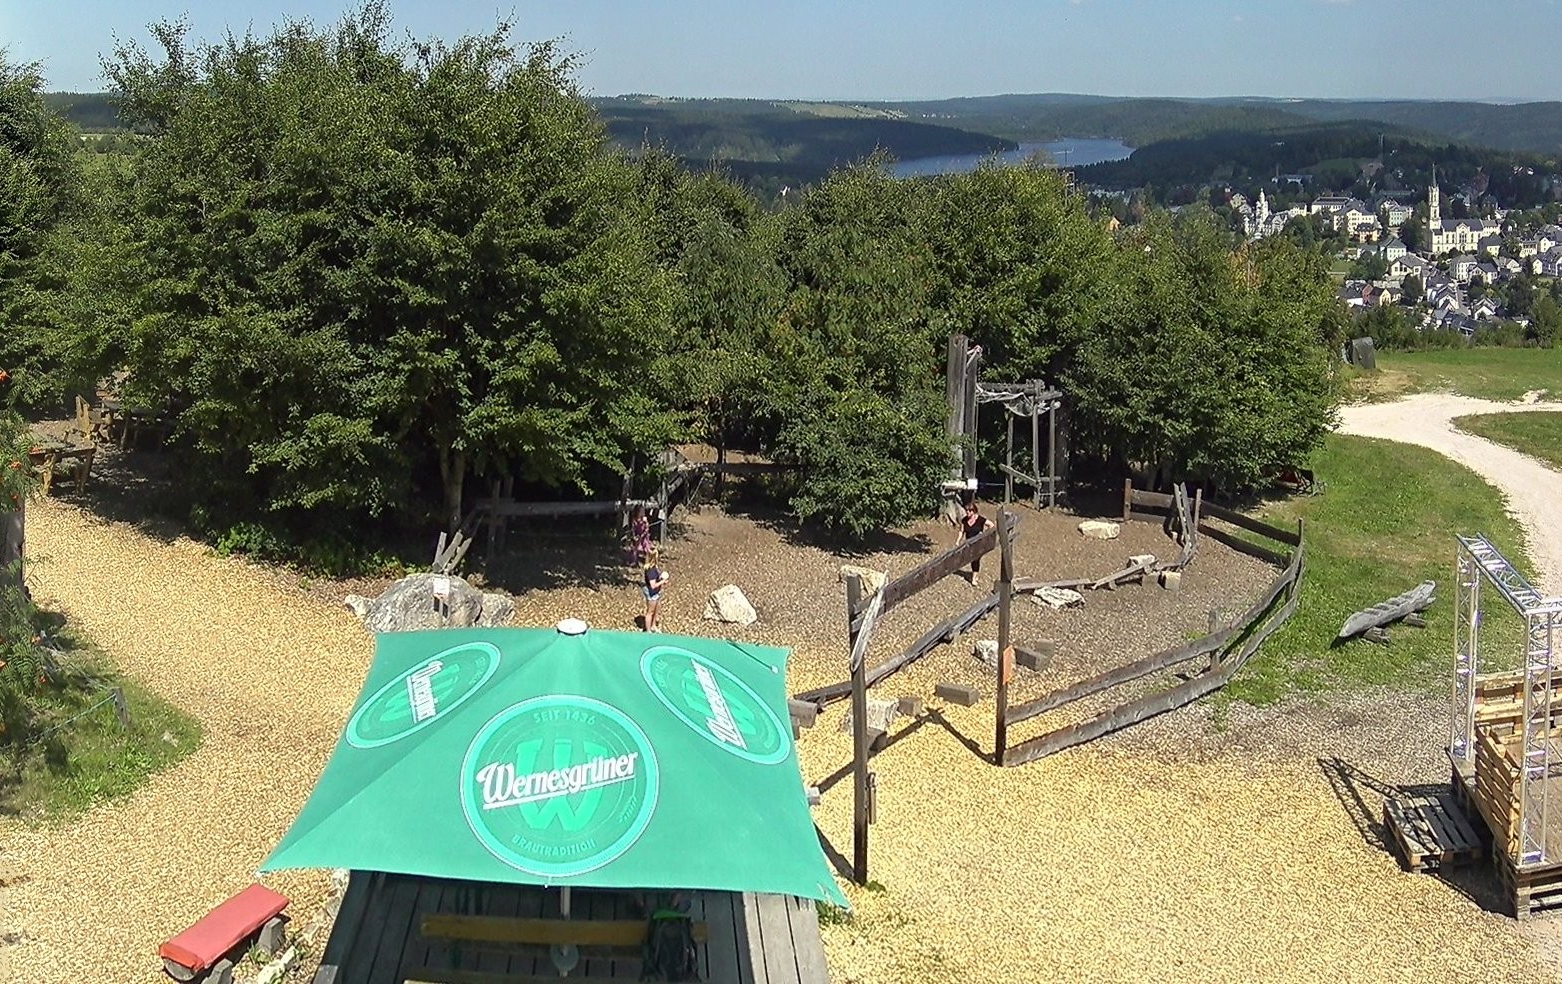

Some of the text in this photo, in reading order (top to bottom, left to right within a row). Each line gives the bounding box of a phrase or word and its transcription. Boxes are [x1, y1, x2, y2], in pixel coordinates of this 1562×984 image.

[533, 709, 596, 725] SEIT 1436
[476, 752, 638, 804] Wernesgrüner
[512, 833, 597, 857] BRAUTRADITION
